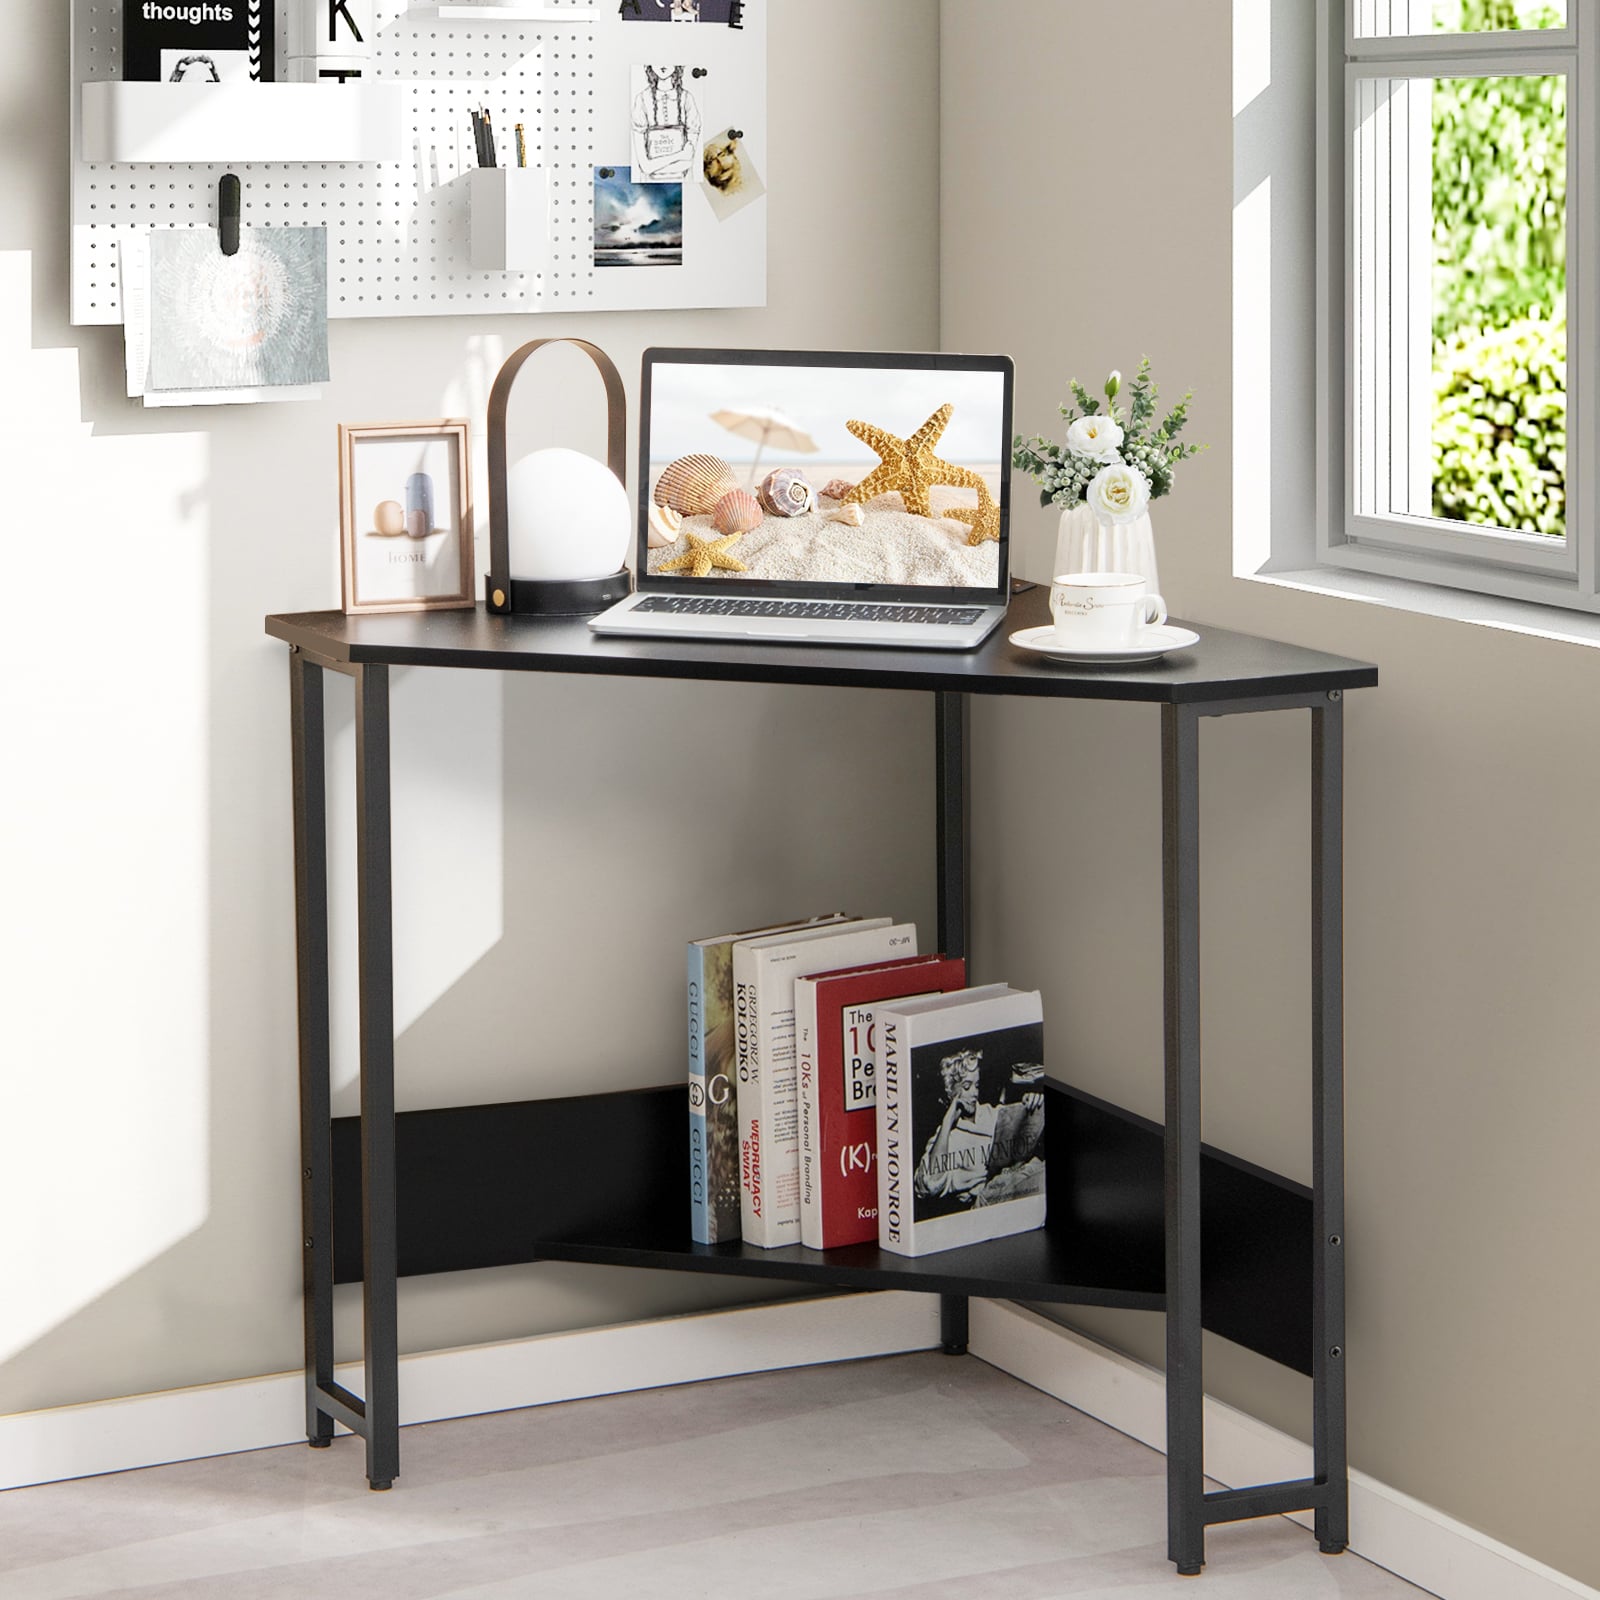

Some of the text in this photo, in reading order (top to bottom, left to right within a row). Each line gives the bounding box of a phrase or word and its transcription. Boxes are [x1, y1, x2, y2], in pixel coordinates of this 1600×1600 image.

[142, 2, 233, 24] thoughts
[689, 981, 699, 1060] GUCCI
[748, 984, 760, 1085] GRZEGORZ W.
[849, 1009, 873, 1025] The
[708, 1074, 729, 1105] G
[801, 1053, 812, 1090] 10Ks
[851, 1058, 874, 1079] Pe
[802, 1101, 811, 1152] Personal
[884, 1022, 901, 1243] MARILYN MONROE
[692, 1128, 703, 1206] GUCCI
[750, 1119, 762, 1218] WĘDRUJĄCY
[804, 1156, 814, 1205] Branding
[921, 1146, 977, 1177] MARILYN
[858, 1206, 878, 1219] Kap
